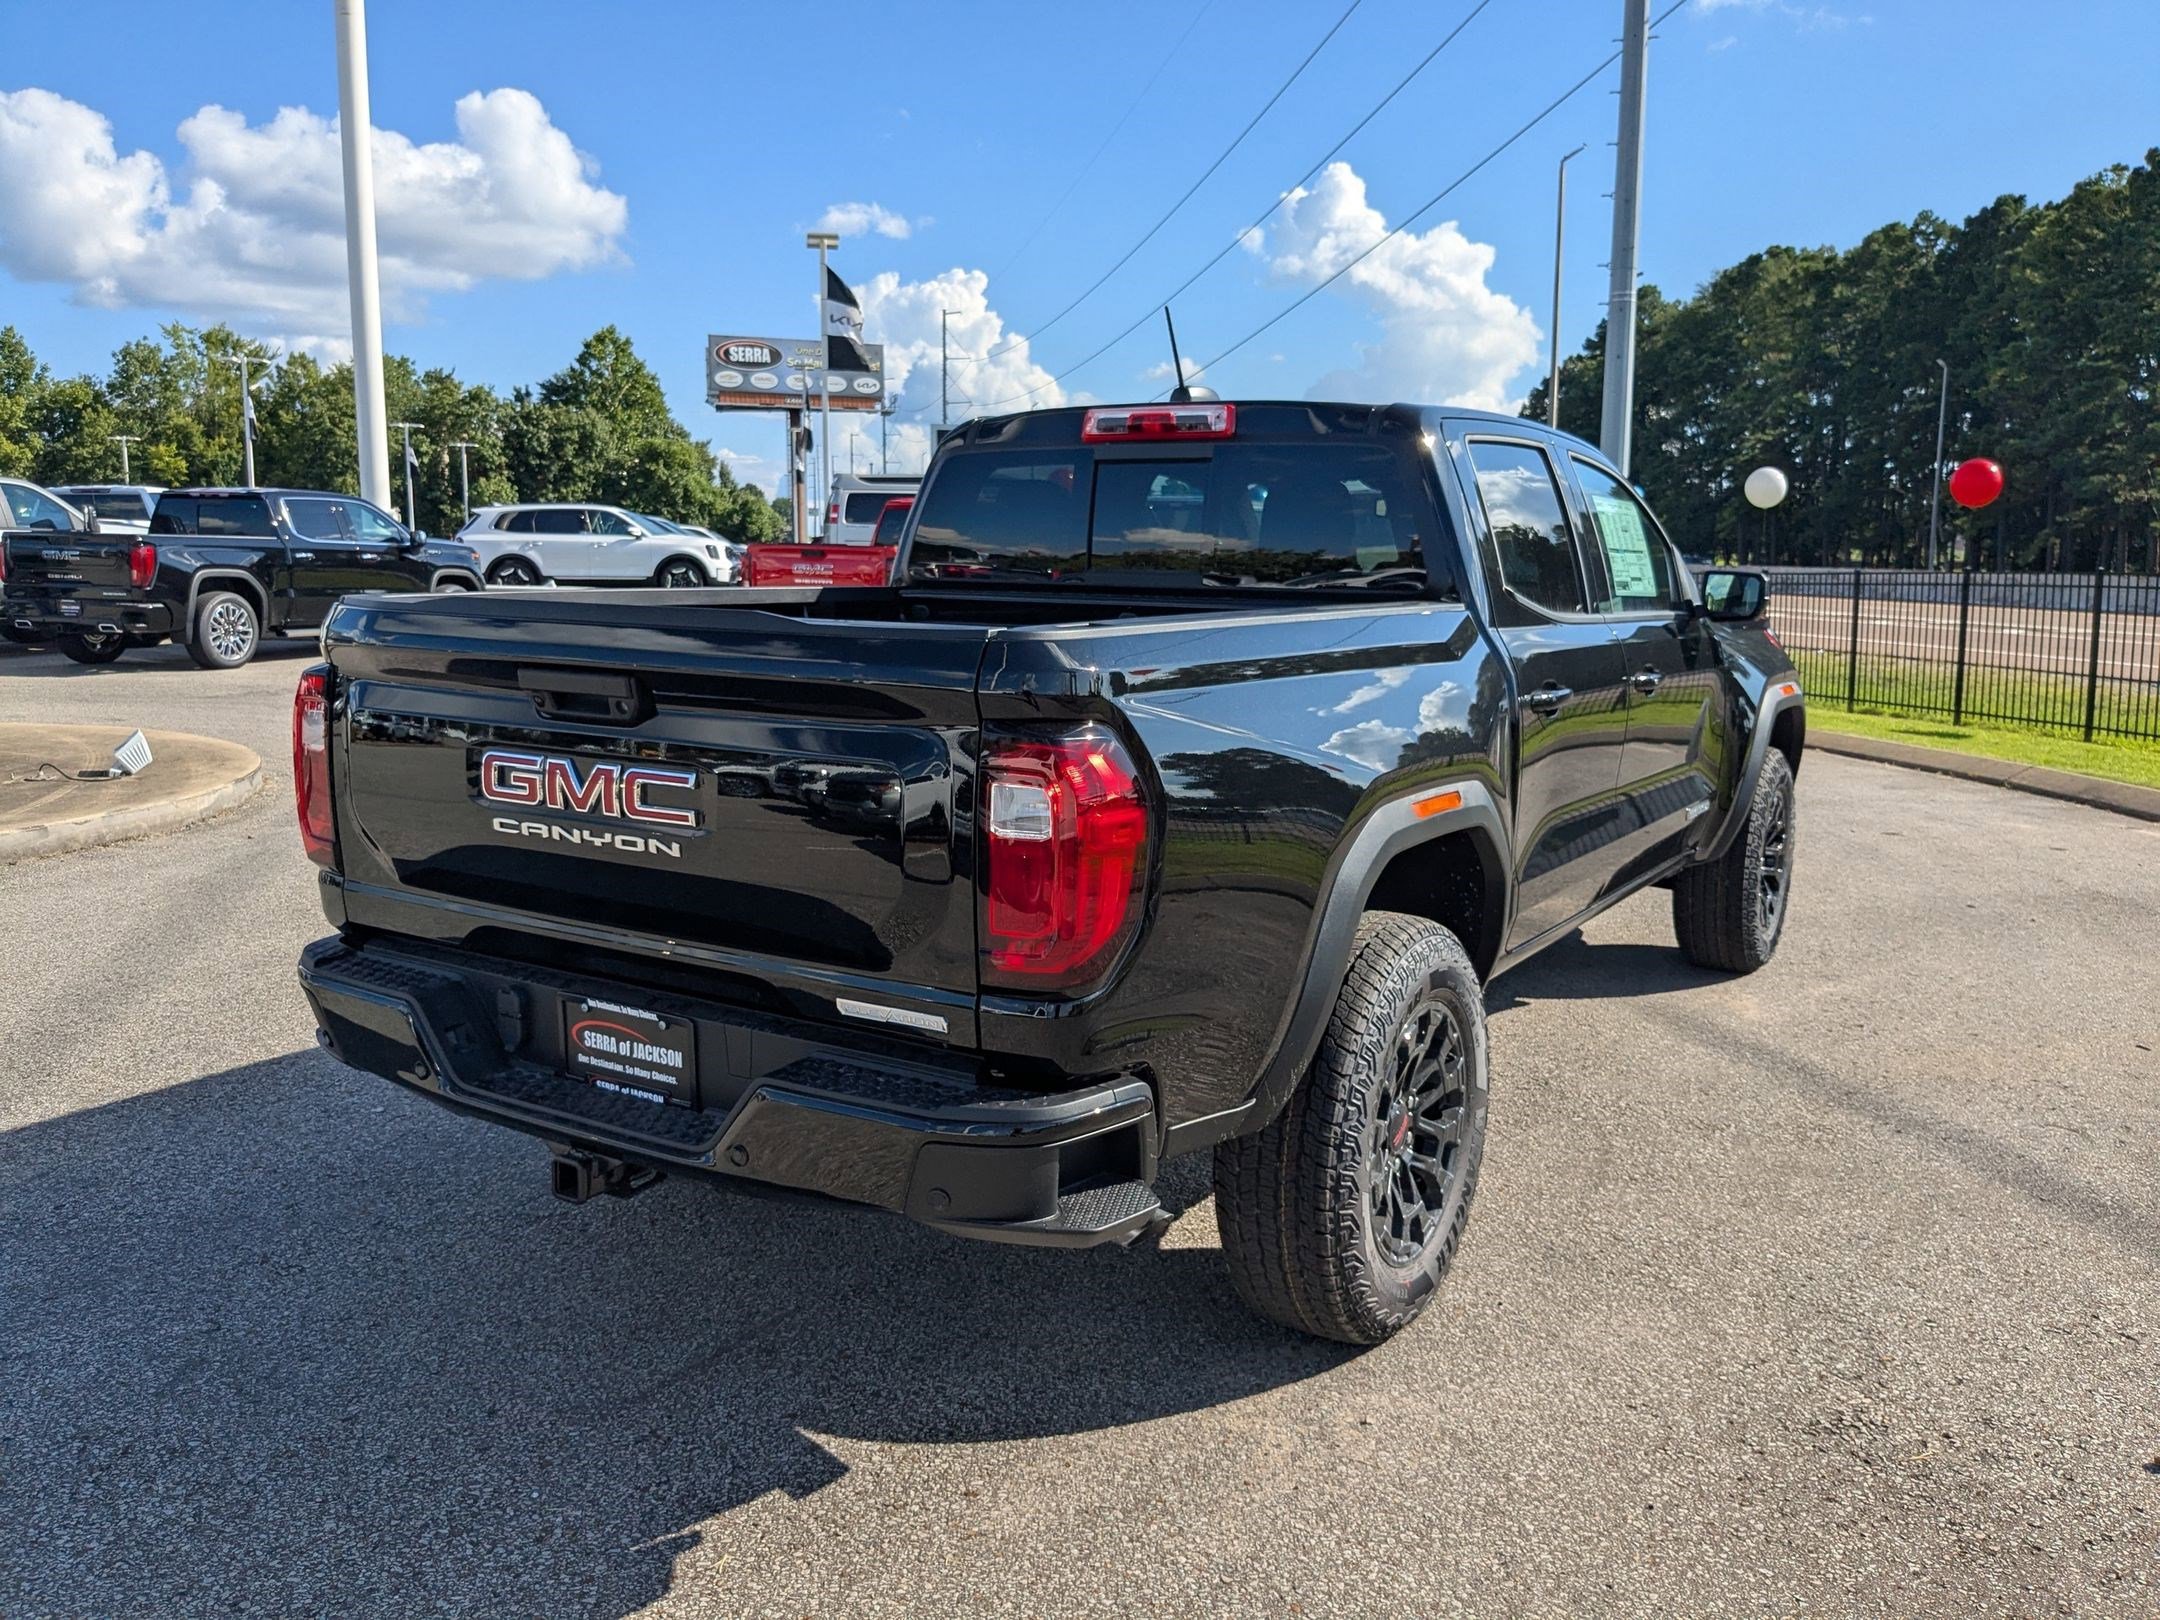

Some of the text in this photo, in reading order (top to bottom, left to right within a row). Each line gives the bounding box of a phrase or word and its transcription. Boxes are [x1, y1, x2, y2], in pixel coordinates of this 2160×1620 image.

[830, 314, 863, 331] KIA
[729, 346, 771, 363] SERRA
[42, 550, 80, 560] GMC
[480, 750, 697, 828] GMC
[492, 817, 681, 858] CANYON
[583, 1030, 683, 1068] SERRA of JACKSON
[578, 1053, 589, 1064] One
[625, 1065, 634, 1076] So
[634, 1066, 651, 1079] Many
[1435, 1106, 1487, 1274] WRANGLER
